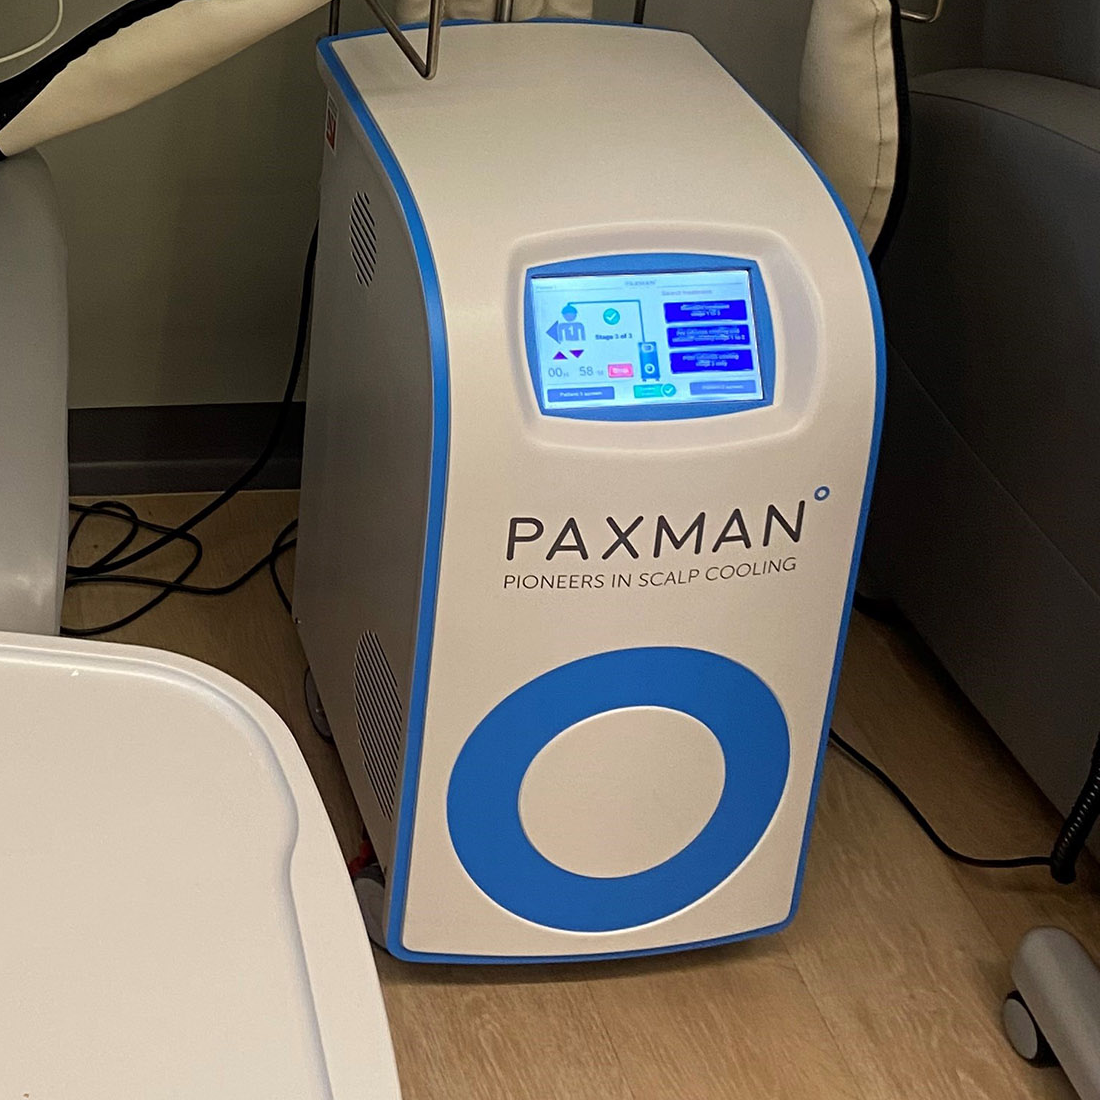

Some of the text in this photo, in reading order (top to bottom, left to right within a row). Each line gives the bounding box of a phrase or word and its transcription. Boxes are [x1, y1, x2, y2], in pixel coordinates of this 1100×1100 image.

[548, 367, 564, 378] 00
[579, 366, 594, 376] 58
[505, 500, 806, 561] PAXMAN
[503, 556, 798, 590] PIONEERS IN SCALP COOLING
